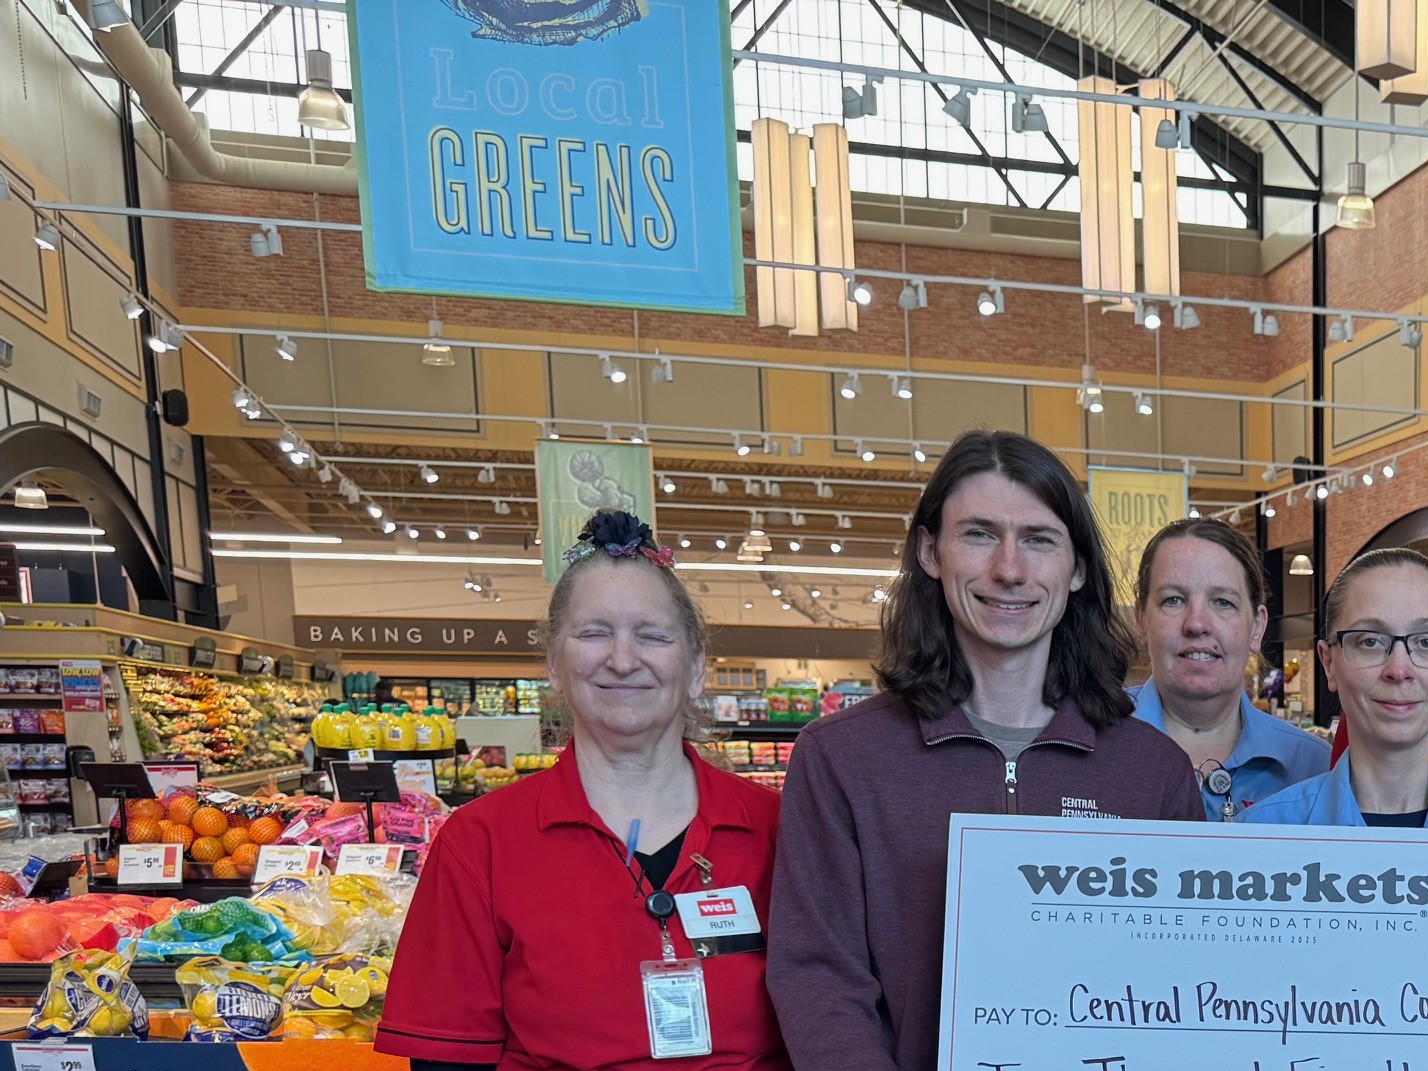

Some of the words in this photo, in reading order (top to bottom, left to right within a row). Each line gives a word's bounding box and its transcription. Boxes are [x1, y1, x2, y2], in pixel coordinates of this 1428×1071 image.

[430, 47, 664, 128] Local
[428, 125, 677, 251] GREENS
[1108, 492, 1169, 528] ROOTS
[309, 626, 423, 644] BAKING
[442, 628, 475, 644] UP
[494, 629, 508, 645] A
[1061, 797, 1098, 810] CENTRAL
[1018, 857, 1158, 898] weis
[700, 901, 734, 914] weis
[710, 920, 735, 929] RUTH
[1031, 910, 1184, 926] CHARITABLE
[1201, 915, 1362, 932] FOUNDATION,
[1375, 920, 1417, 932] INC.
[1130, 932, 1216, 941] INCORPORATED
[1225, 934, 1282, 943] DELAWARE
[974, 1007, 1015, 1026] PAY
[1020, 1008, 1058, 1026] TO:
[1069, 983, 1181, 1026] Central
[1196, 981, 1386, 1045] Pennsylvania
